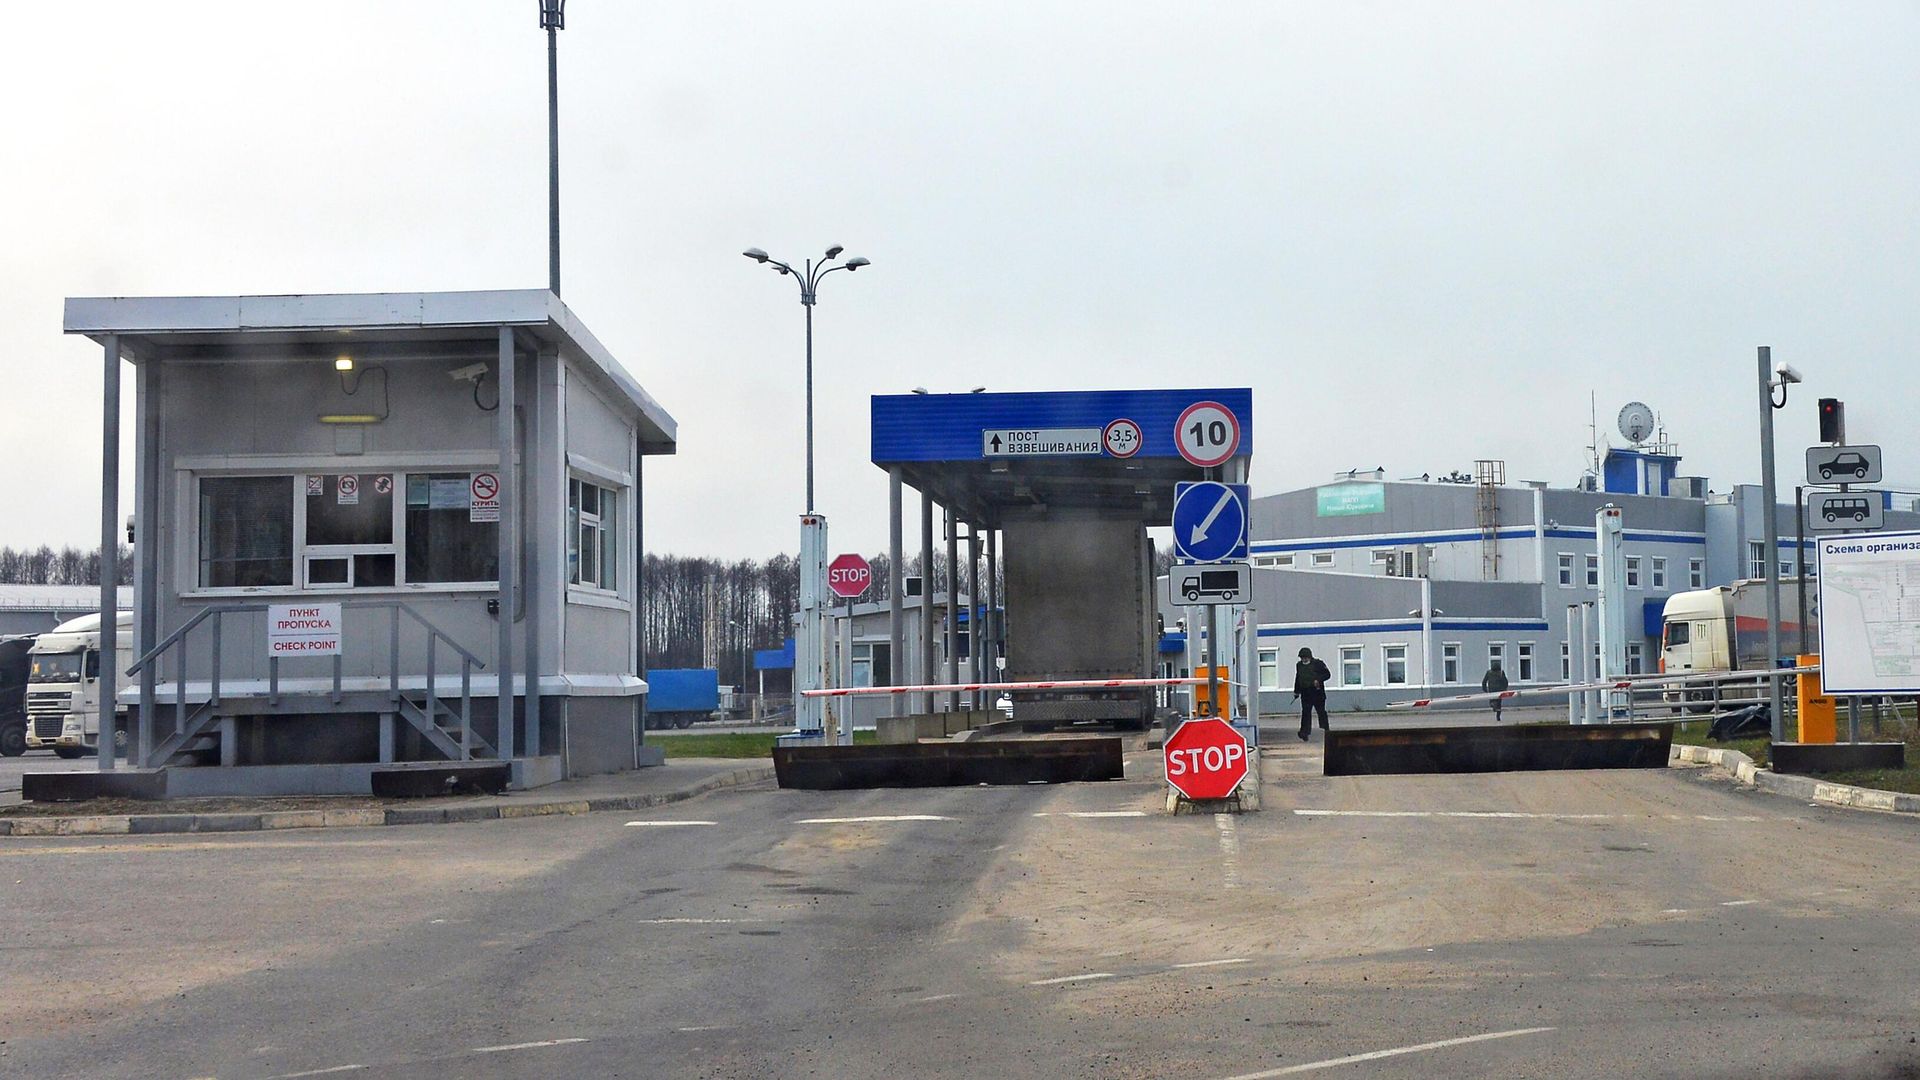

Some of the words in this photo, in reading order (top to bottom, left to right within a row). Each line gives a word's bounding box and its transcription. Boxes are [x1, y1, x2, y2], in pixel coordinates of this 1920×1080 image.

[1008, 431, 1040, 442] ПОСТ
[1189, 420, 1227, 447] 10
[1008, 442, 1098, 453] ВЗВЕШИВАНИЯ
[1826, 544, 1863, 554] Схема
[831, 568, 869, 582] STOP
[289, 608, 320, 617] ПУНКТ
[277, 620, 332, 629] ПРОПУСКА
[273, 641, 306, 651] CHECK
[308, 640, 336, 650] POINT
[1169, 743, 1243, 776] STOP
